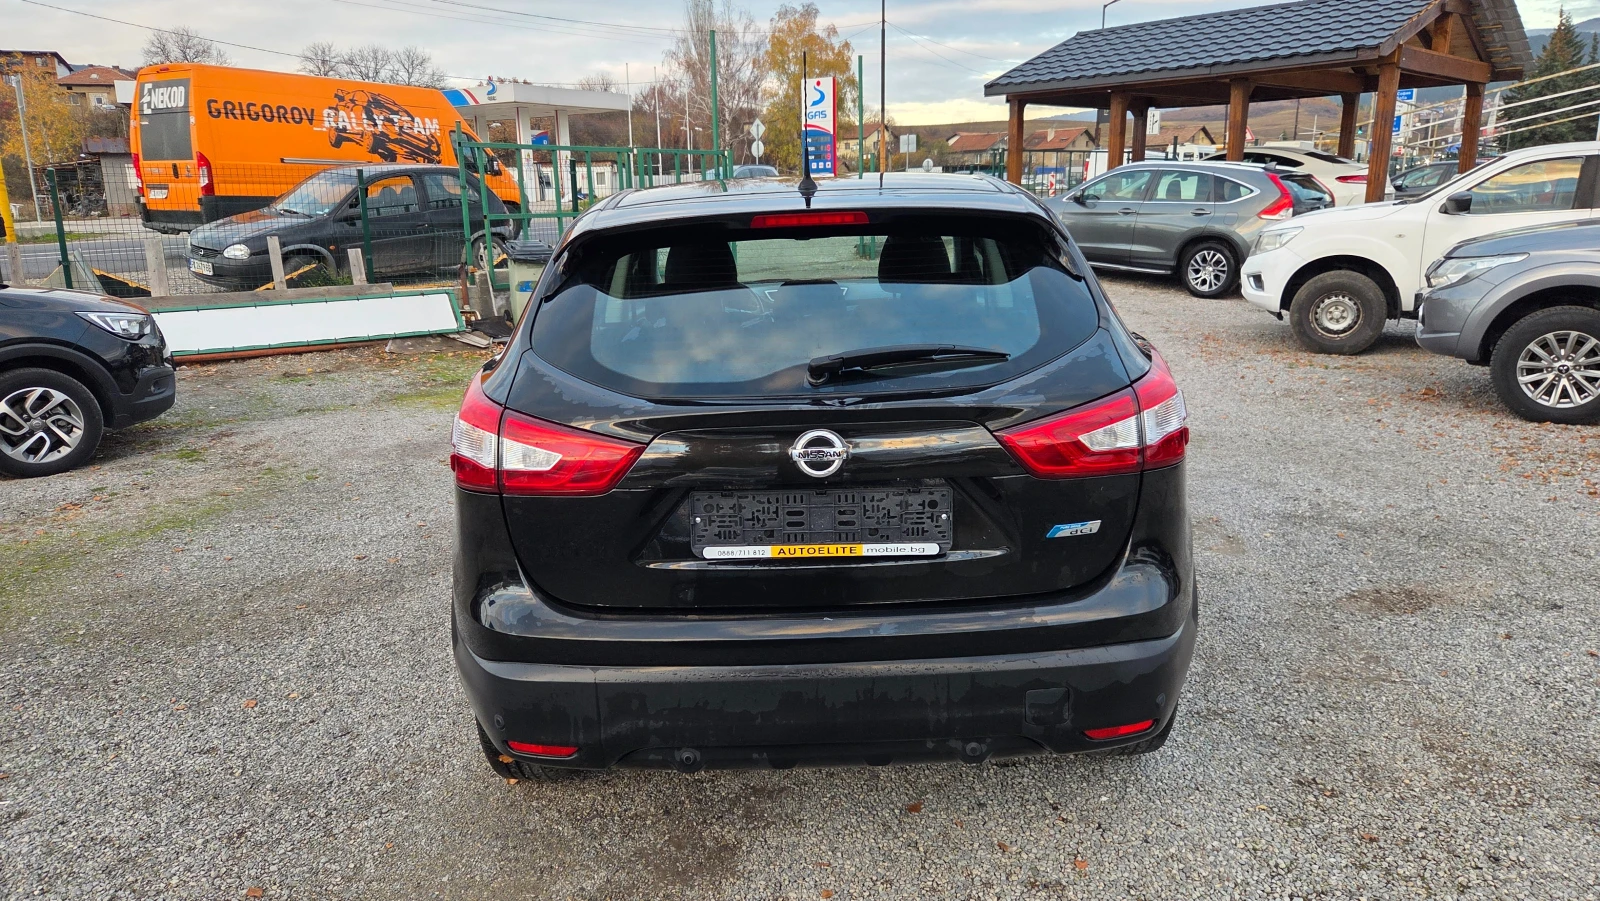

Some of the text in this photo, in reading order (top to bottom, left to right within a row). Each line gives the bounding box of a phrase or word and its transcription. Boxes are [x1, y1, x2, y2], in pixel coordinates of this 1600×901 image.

[140, 83, 185, 114] ENEKOD
[206, 98, 315, 126] GRIGOROV
[807, 110, 827, 120] GAS
[322, 108, 440, 136] RALLY TEAM
[797, 450, 841, 459] NISSAN
[777, 546, 857, 556] AUTOELITE
